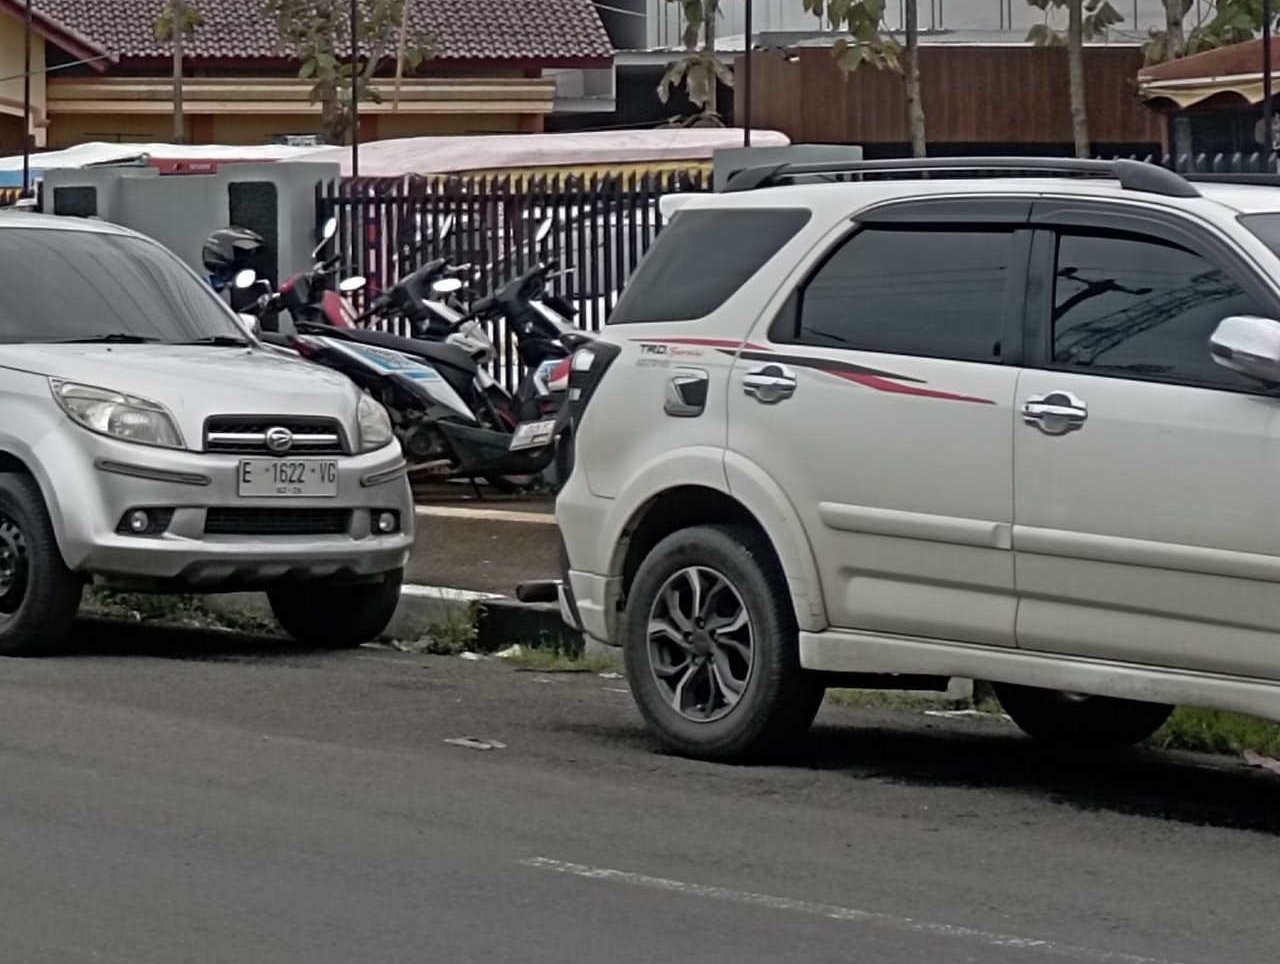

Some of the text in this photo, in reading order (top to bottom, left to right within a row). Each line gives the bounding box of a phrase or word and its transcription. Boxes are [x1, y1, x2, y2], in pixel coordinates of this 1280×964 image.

[242, 462, 336, 483] E 1622 VG
